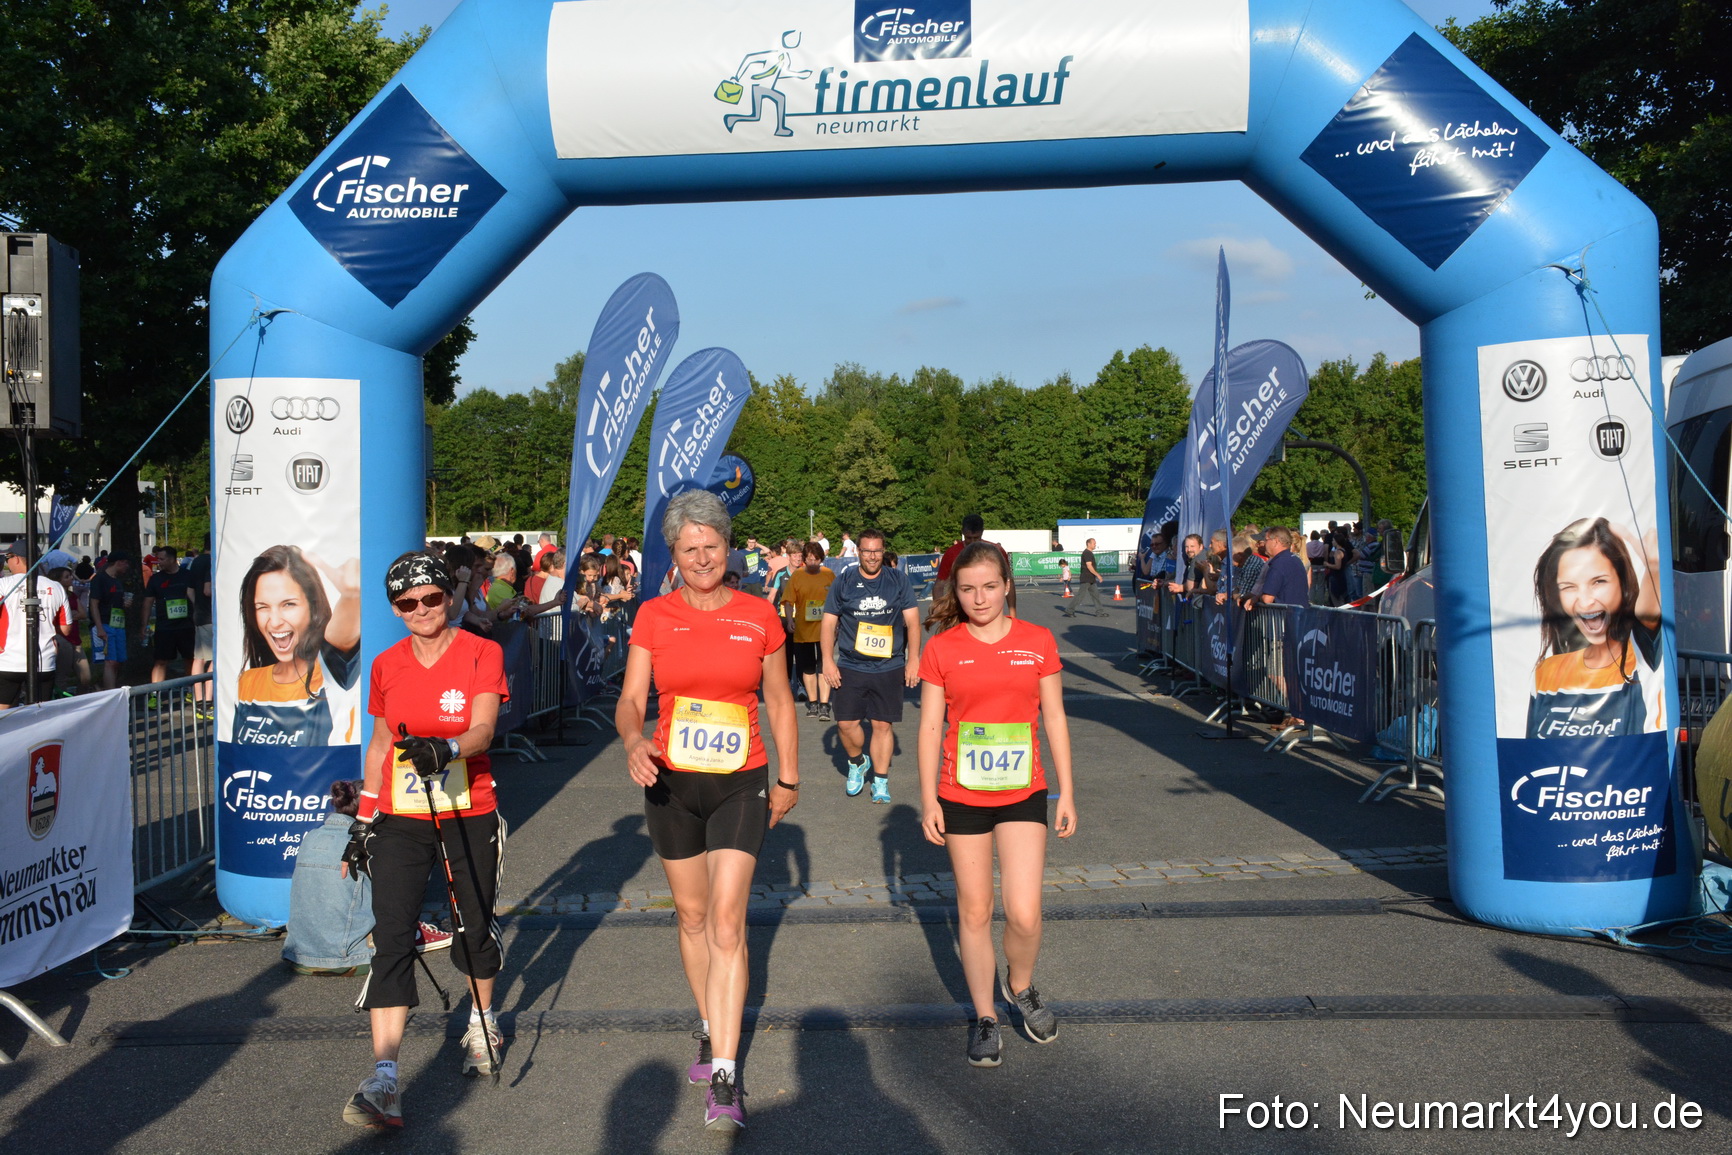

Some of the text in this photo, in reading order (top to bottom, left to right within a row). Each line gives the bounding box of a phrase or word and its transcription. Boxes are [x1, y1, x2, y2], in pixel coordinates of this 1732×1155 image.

[879, 19, 964, 37] Fischer
[887, 35, 958, 45] AUTOMOBILE
[815, 55, 1074, 114] firmenlauf
[816, 115, 920, 135] neumarkt
[1471, 141, 1515, 158] mit!
[336, 177, 470, 204] Fischer
[346, 207, 459, 219] AUTOMOBILE
[602, 305, 656, 455] Fischer
[1572, 388, 1604, 399] Audi
[273, 427, 302, 436] Audi
[670, 371, 729, 480] Fischer
[689, 390, 735, 478] AUTOMOBILE
[1231, 388, 1288, 475] AUTOMOBILE
[1599, 428, 1623, 449] FIAT
[295, 464, 320, 483] FIAT
[1503, 457, 1562, 470] SEAT
[225, 487, 262, 495] SEAT
[864, 636, 886, 649] 190
[1303, 658, 1356, 698] Fischer
[1309, 694, 1353, 718] AUTOMOBILE
[439, 714, 465, 723] caritas
[679, 726, 741, 754] 1049
[966, 749, 1025, 771] 1047
[235, 788, 332, 810] Fischer
[1537, 784, 1652, 808] Fischer
[242, 811, 325, 823] AUTOMOBILE
[1549, 807, 1647, 821] AUTOMOBILE
[279, 831, 301, 843] das
[1601, 829, 1625, 844] das
[1626, 823, 1667, 840] Lächeln
[1605, 837, 1665, 862] fährt mit!
[0, 845, 87, 900] Neumarkter
